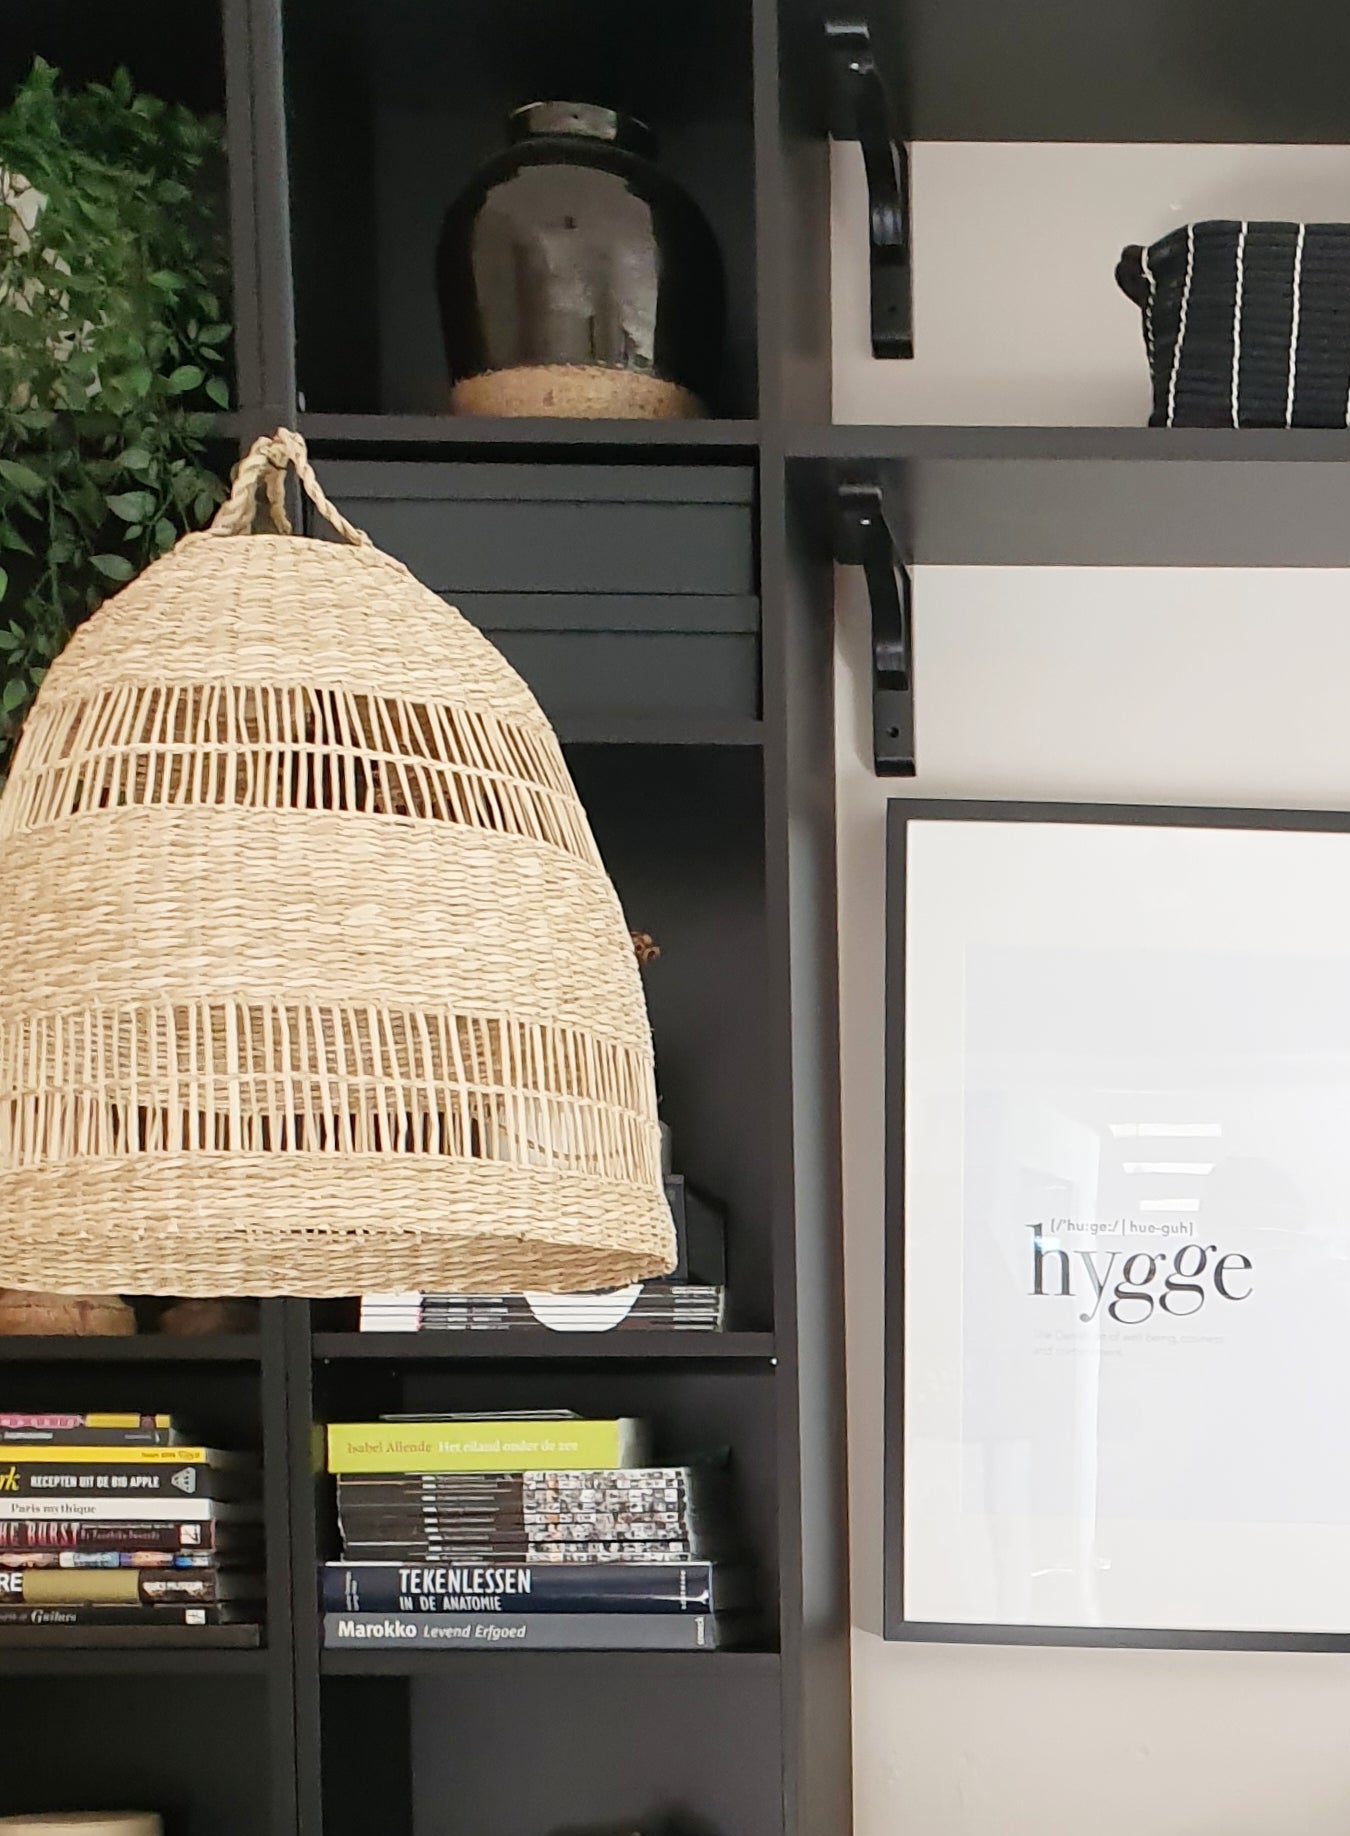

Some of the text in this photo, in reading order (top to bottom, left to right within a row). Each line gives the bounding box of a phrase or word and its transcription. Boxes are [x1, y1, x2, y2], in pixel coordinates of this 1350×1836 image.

[1025, 1222, 1253, 1324] hygge
[346, 1441, 382, 1453] Isabel
[386, 1441, 430, 1453] Allende
[30, 1475, 78, 1488] RECEPTEN
[130, 1475, 160, 1488] APPLE
[10, 1503, 41, 1514] Paris
[399, 1569, 531, 1594] TEKENLESSEN
[400, 1595, 502, 1611] IN DE ANATOMIE
[338, 1621, 527, 1641] Marokko Levend Erfgoed
